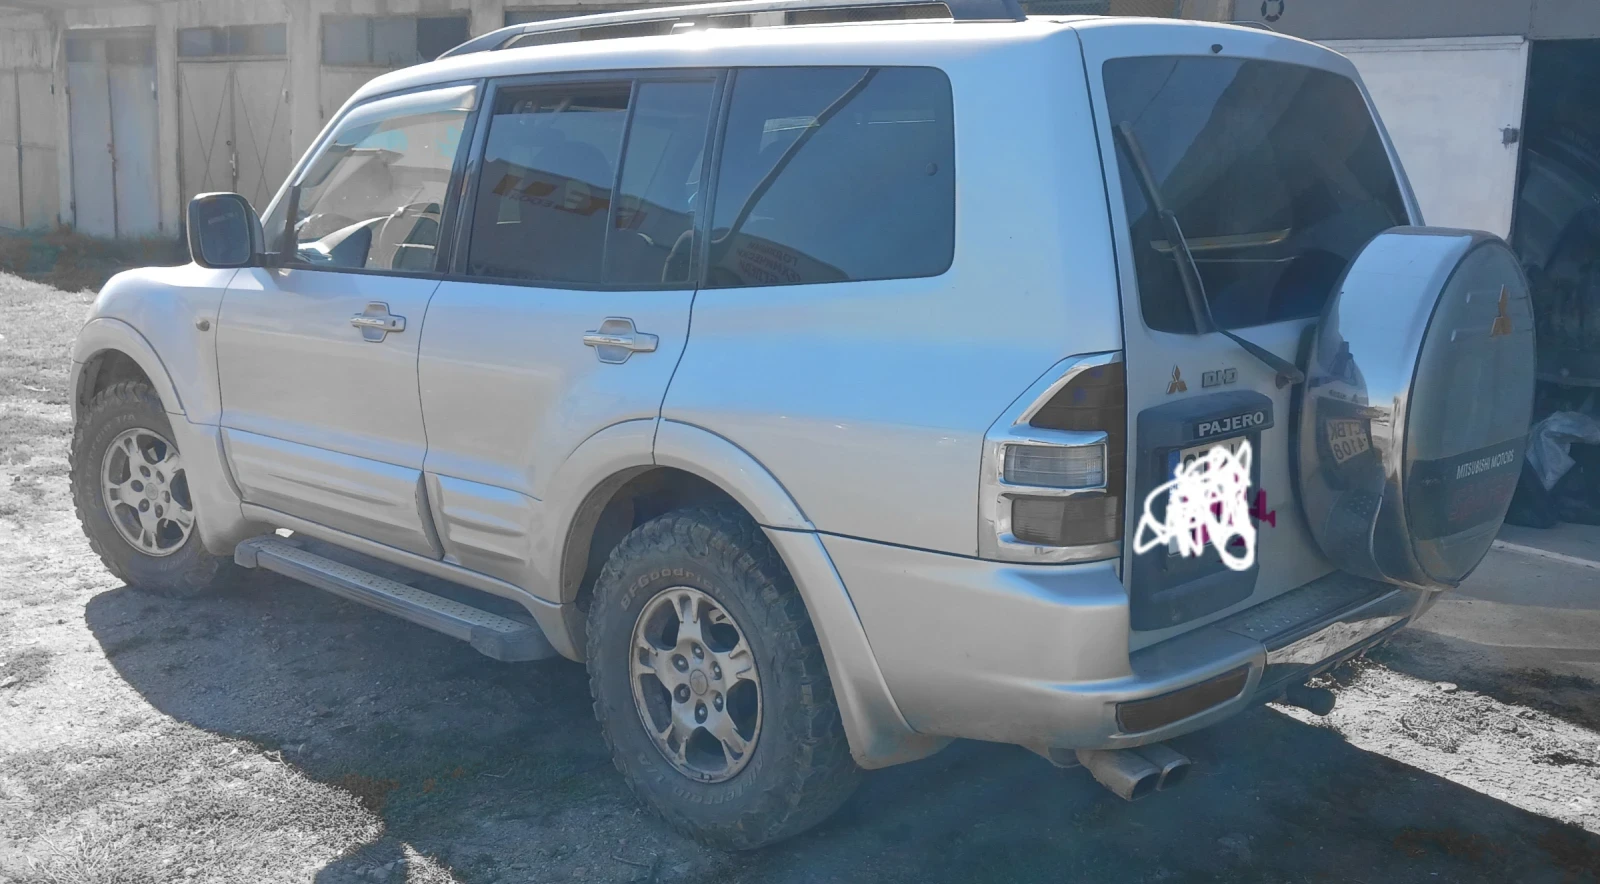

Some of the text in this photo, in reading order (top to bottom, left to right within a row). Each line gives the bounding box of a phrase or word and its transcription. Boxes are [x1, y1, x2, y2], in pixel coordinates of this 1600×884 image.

[1198, 411, 1264, 437] PAJERO
[1456, 448, 1515, 480] MITSUBISHI MOTORS
